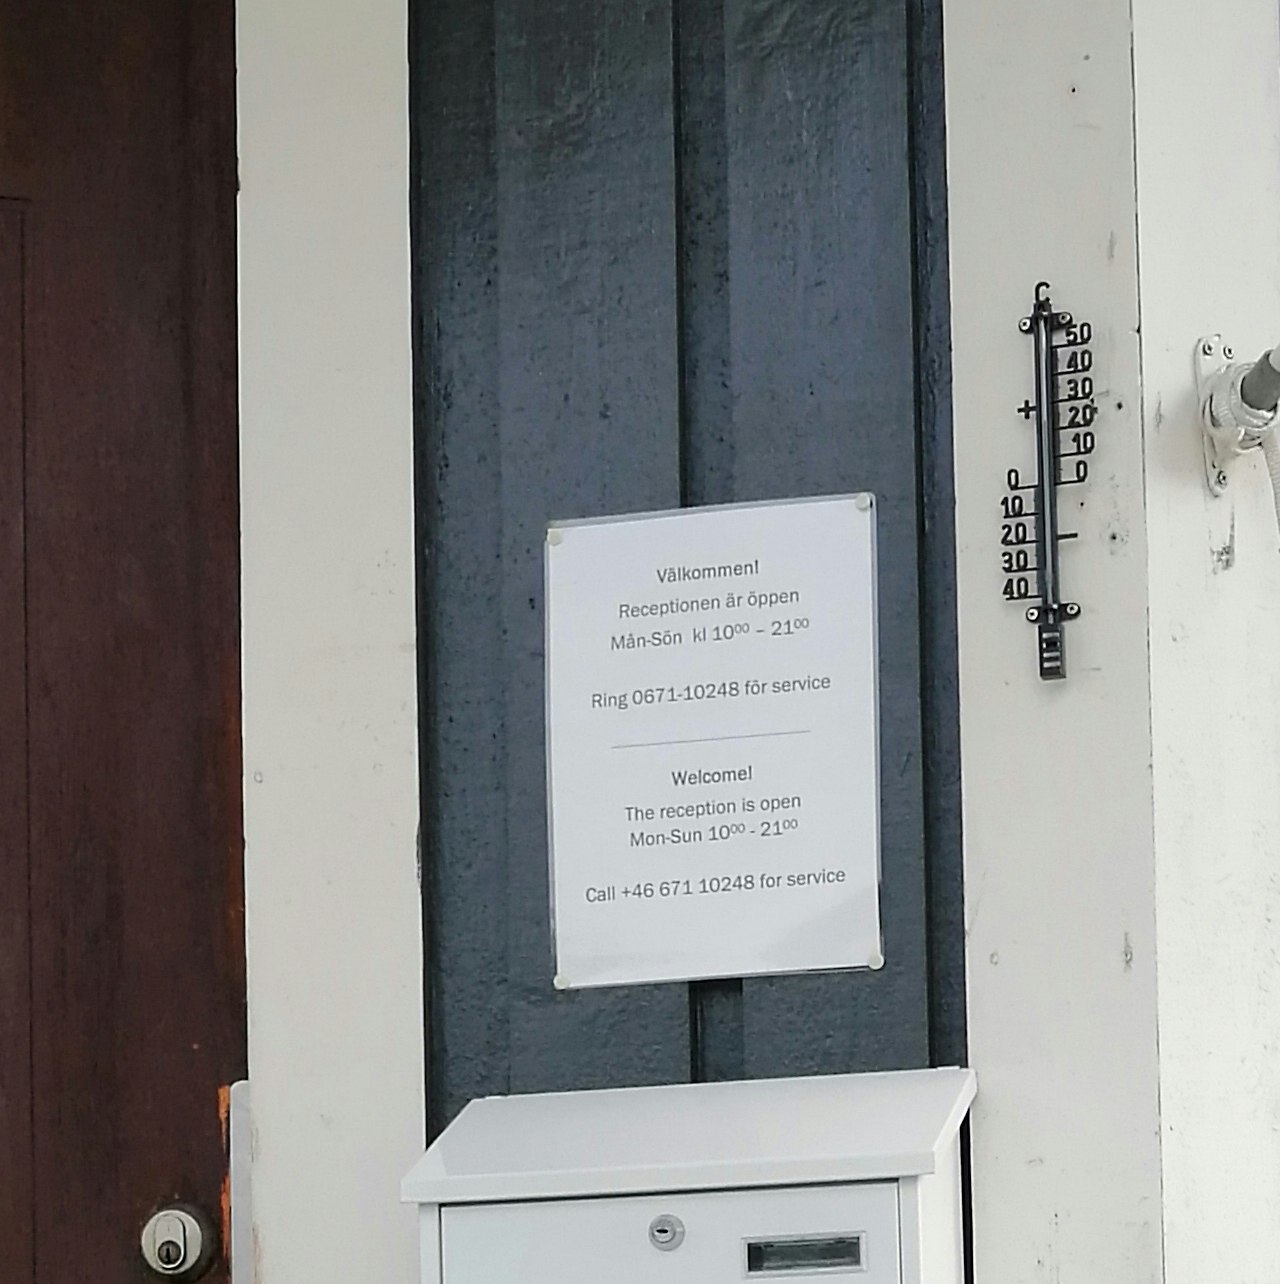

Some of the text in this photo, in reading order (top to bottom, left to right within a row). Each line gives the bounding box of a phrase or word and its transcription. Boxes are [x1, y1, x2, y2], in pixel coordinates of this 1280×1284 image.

[1065, 322, 1092, 344] 50
[1066, 349, 1093, 370] 40
[1067, 377, 1093, 398] 30
[1068, 404, 1094, 426] 20
[1072, 432, 1095, 453] 10
[1007, 469, 1019, 490] 0
[1076, 460, 1088, 482] 0
[1001, 495, 1023, 517] 10
[1001, 523, 1027, 545] 20
[656, 559, 759, 584] Välkommen!
[1001, 550, 1028, 572] 30
[1003, 577, 1029, 600] 40
[619, 590, 799, 619] Receptionen är öppen
[611, 630, 682, 650] Mån-Sön
[692, 627, 707, 643] kl
[591, 675, 831, 710] Ring 0671-10248 för service
[671, 766, 753, 786] Welcome!
[624, 795, 802, 822] The reception is open
[629, 828, 702, 847] Mon-Sun
[585, 868, 846, 903] Call +46 671 10248 for service
